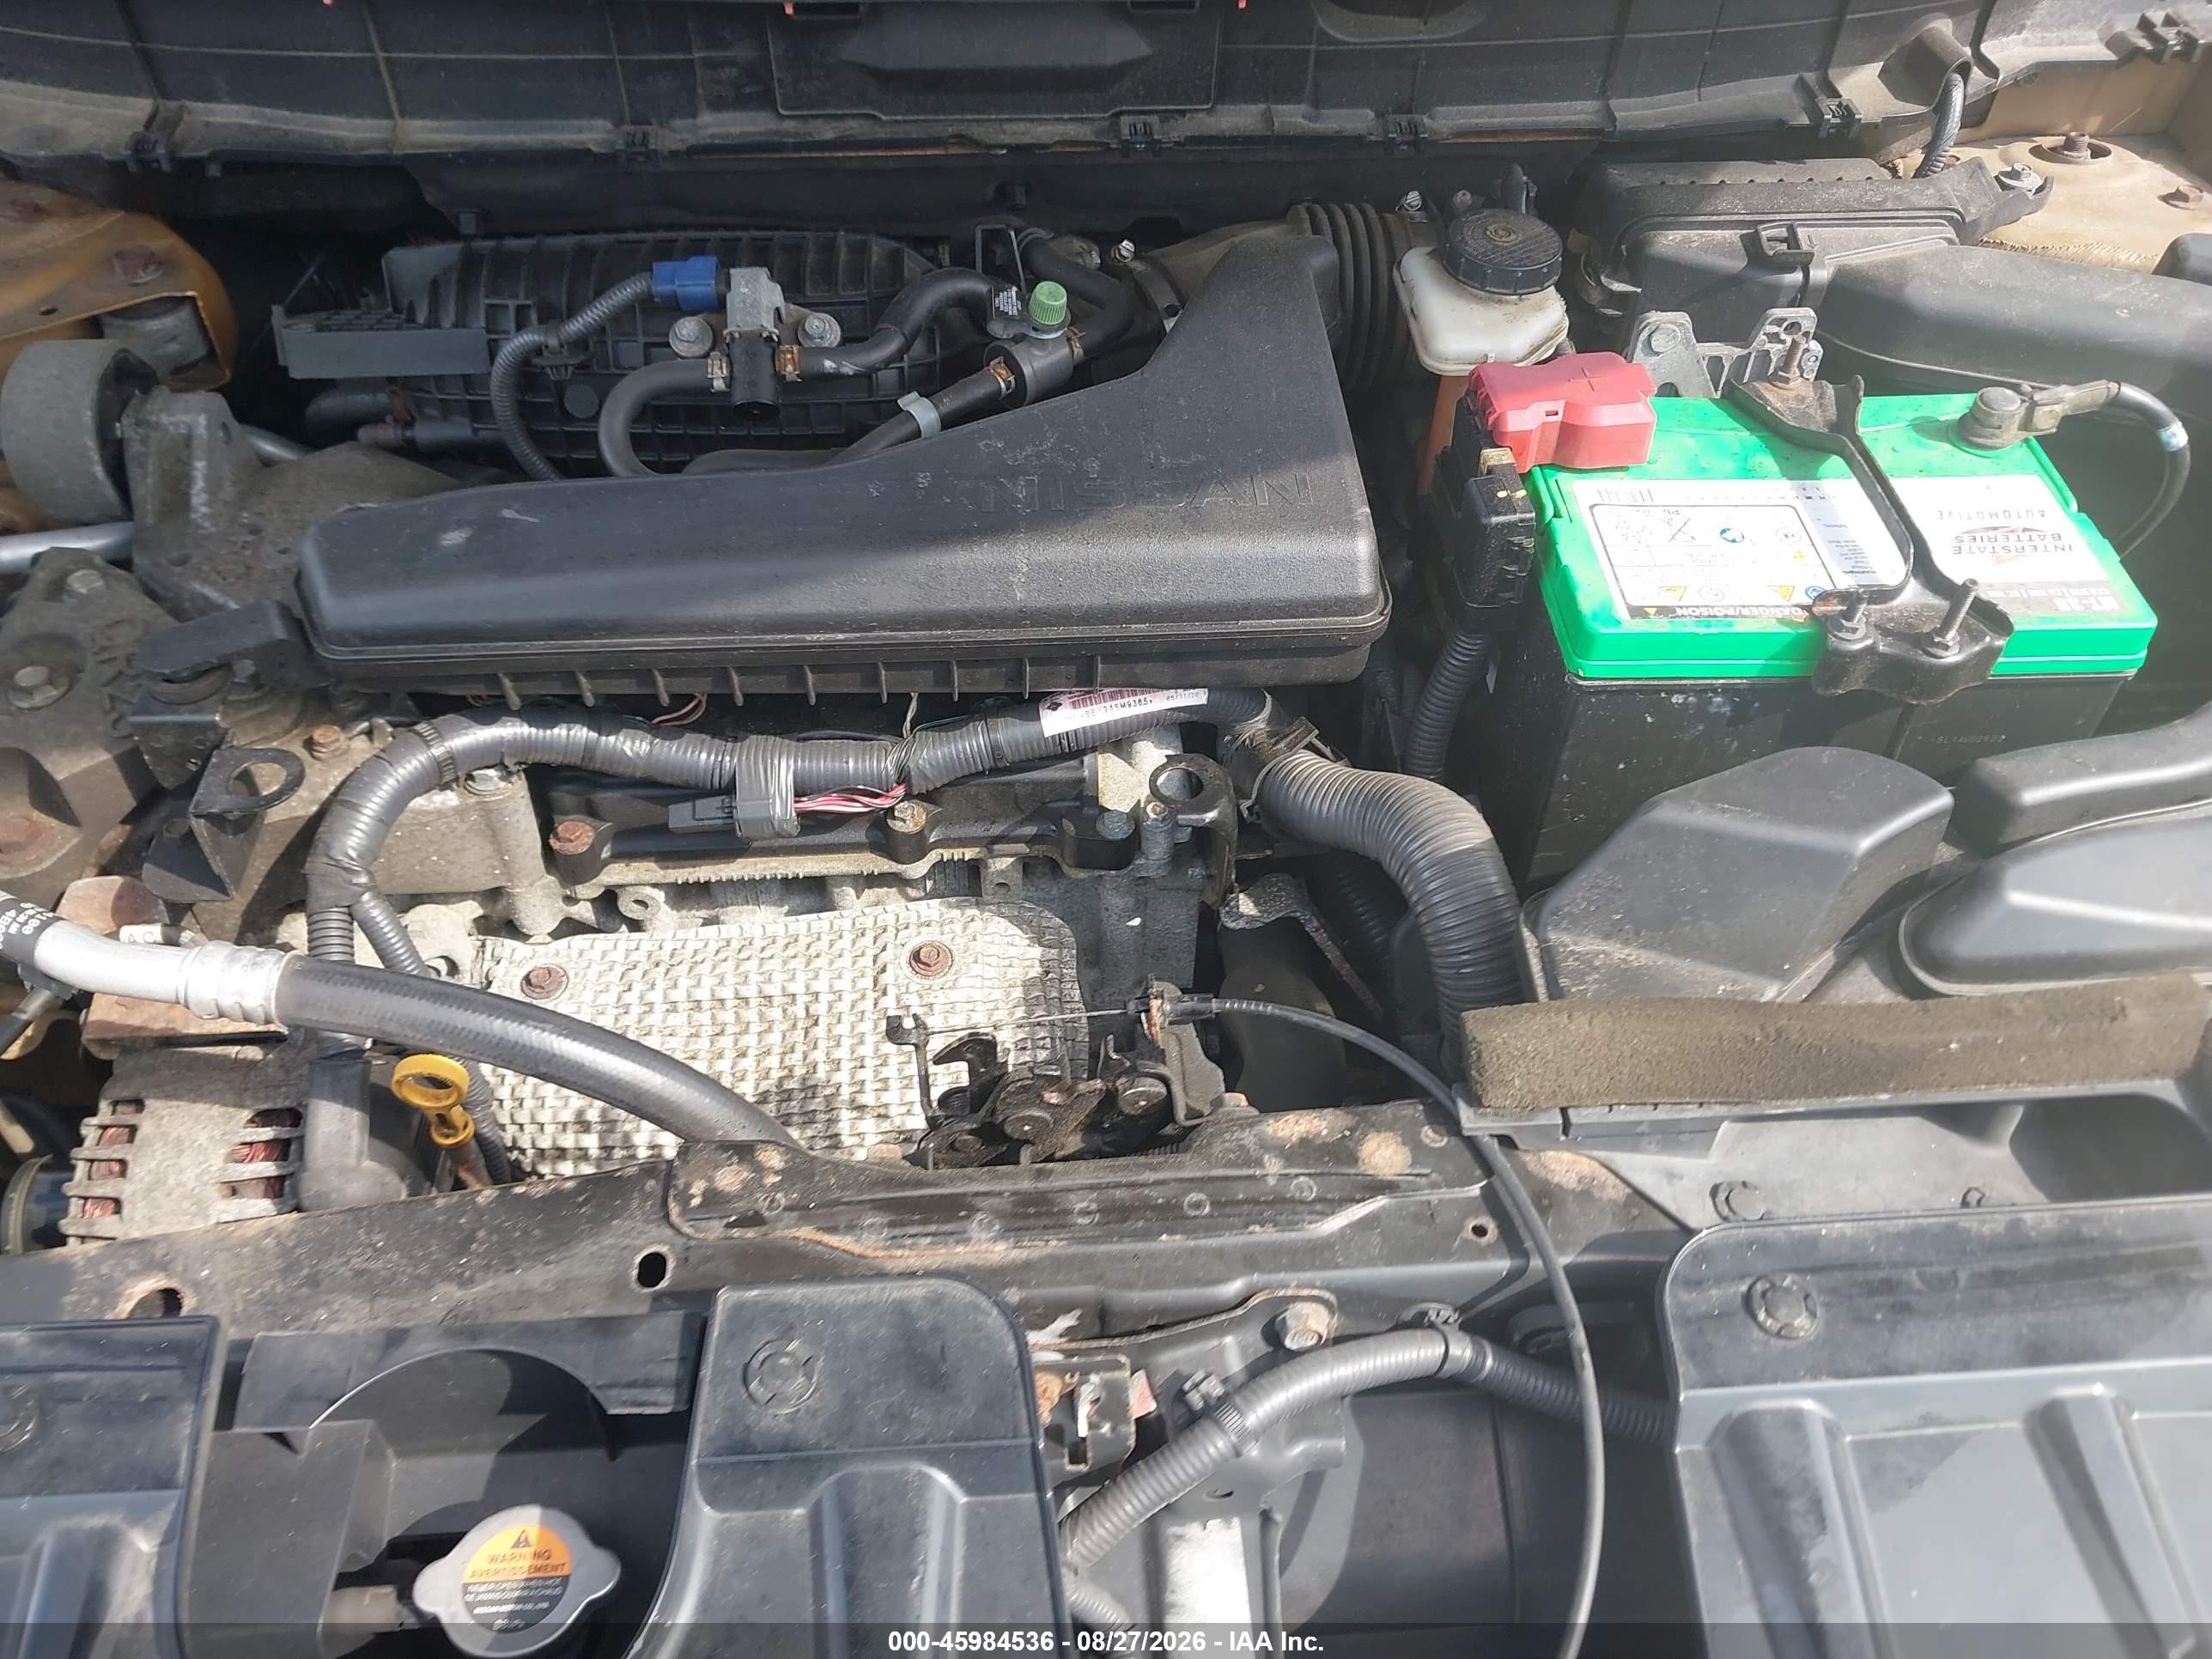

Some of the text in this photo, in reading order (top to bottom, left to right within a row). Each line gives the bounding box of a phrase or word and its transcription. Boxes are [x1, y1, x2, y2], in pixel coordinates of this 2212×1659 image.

[1937, 509, 2045, 520] AUTOMOTIVE
[1954, 532, 2062, 544] BATTERIES
[1952, 544, 2072, 555] INTERSTATE
[488, 1548, 551, 1564] WARNING
